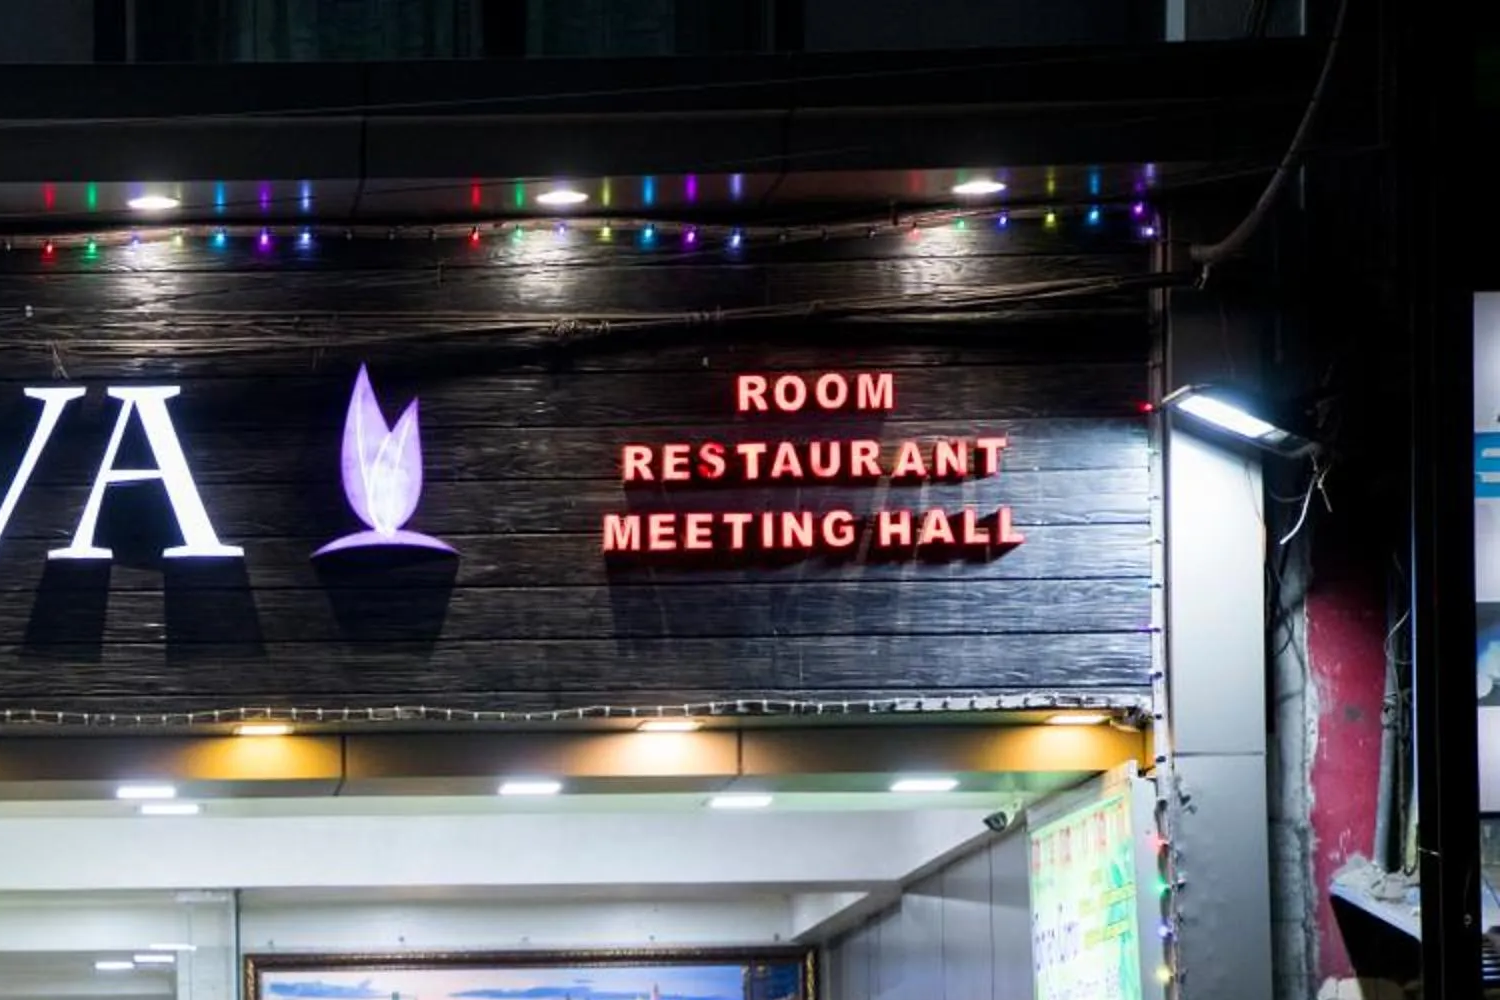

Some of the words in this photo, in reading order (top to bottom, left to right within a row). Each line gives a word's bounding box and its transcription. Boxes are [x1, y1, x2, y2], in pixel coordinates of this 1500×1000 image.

[738, 373, 893, 411] ROOM
[622, 436, 1008, 481] RESTAURANT
[603, 510, 856, 551] MEETING
[879, 505, 1026, 546] HALL
